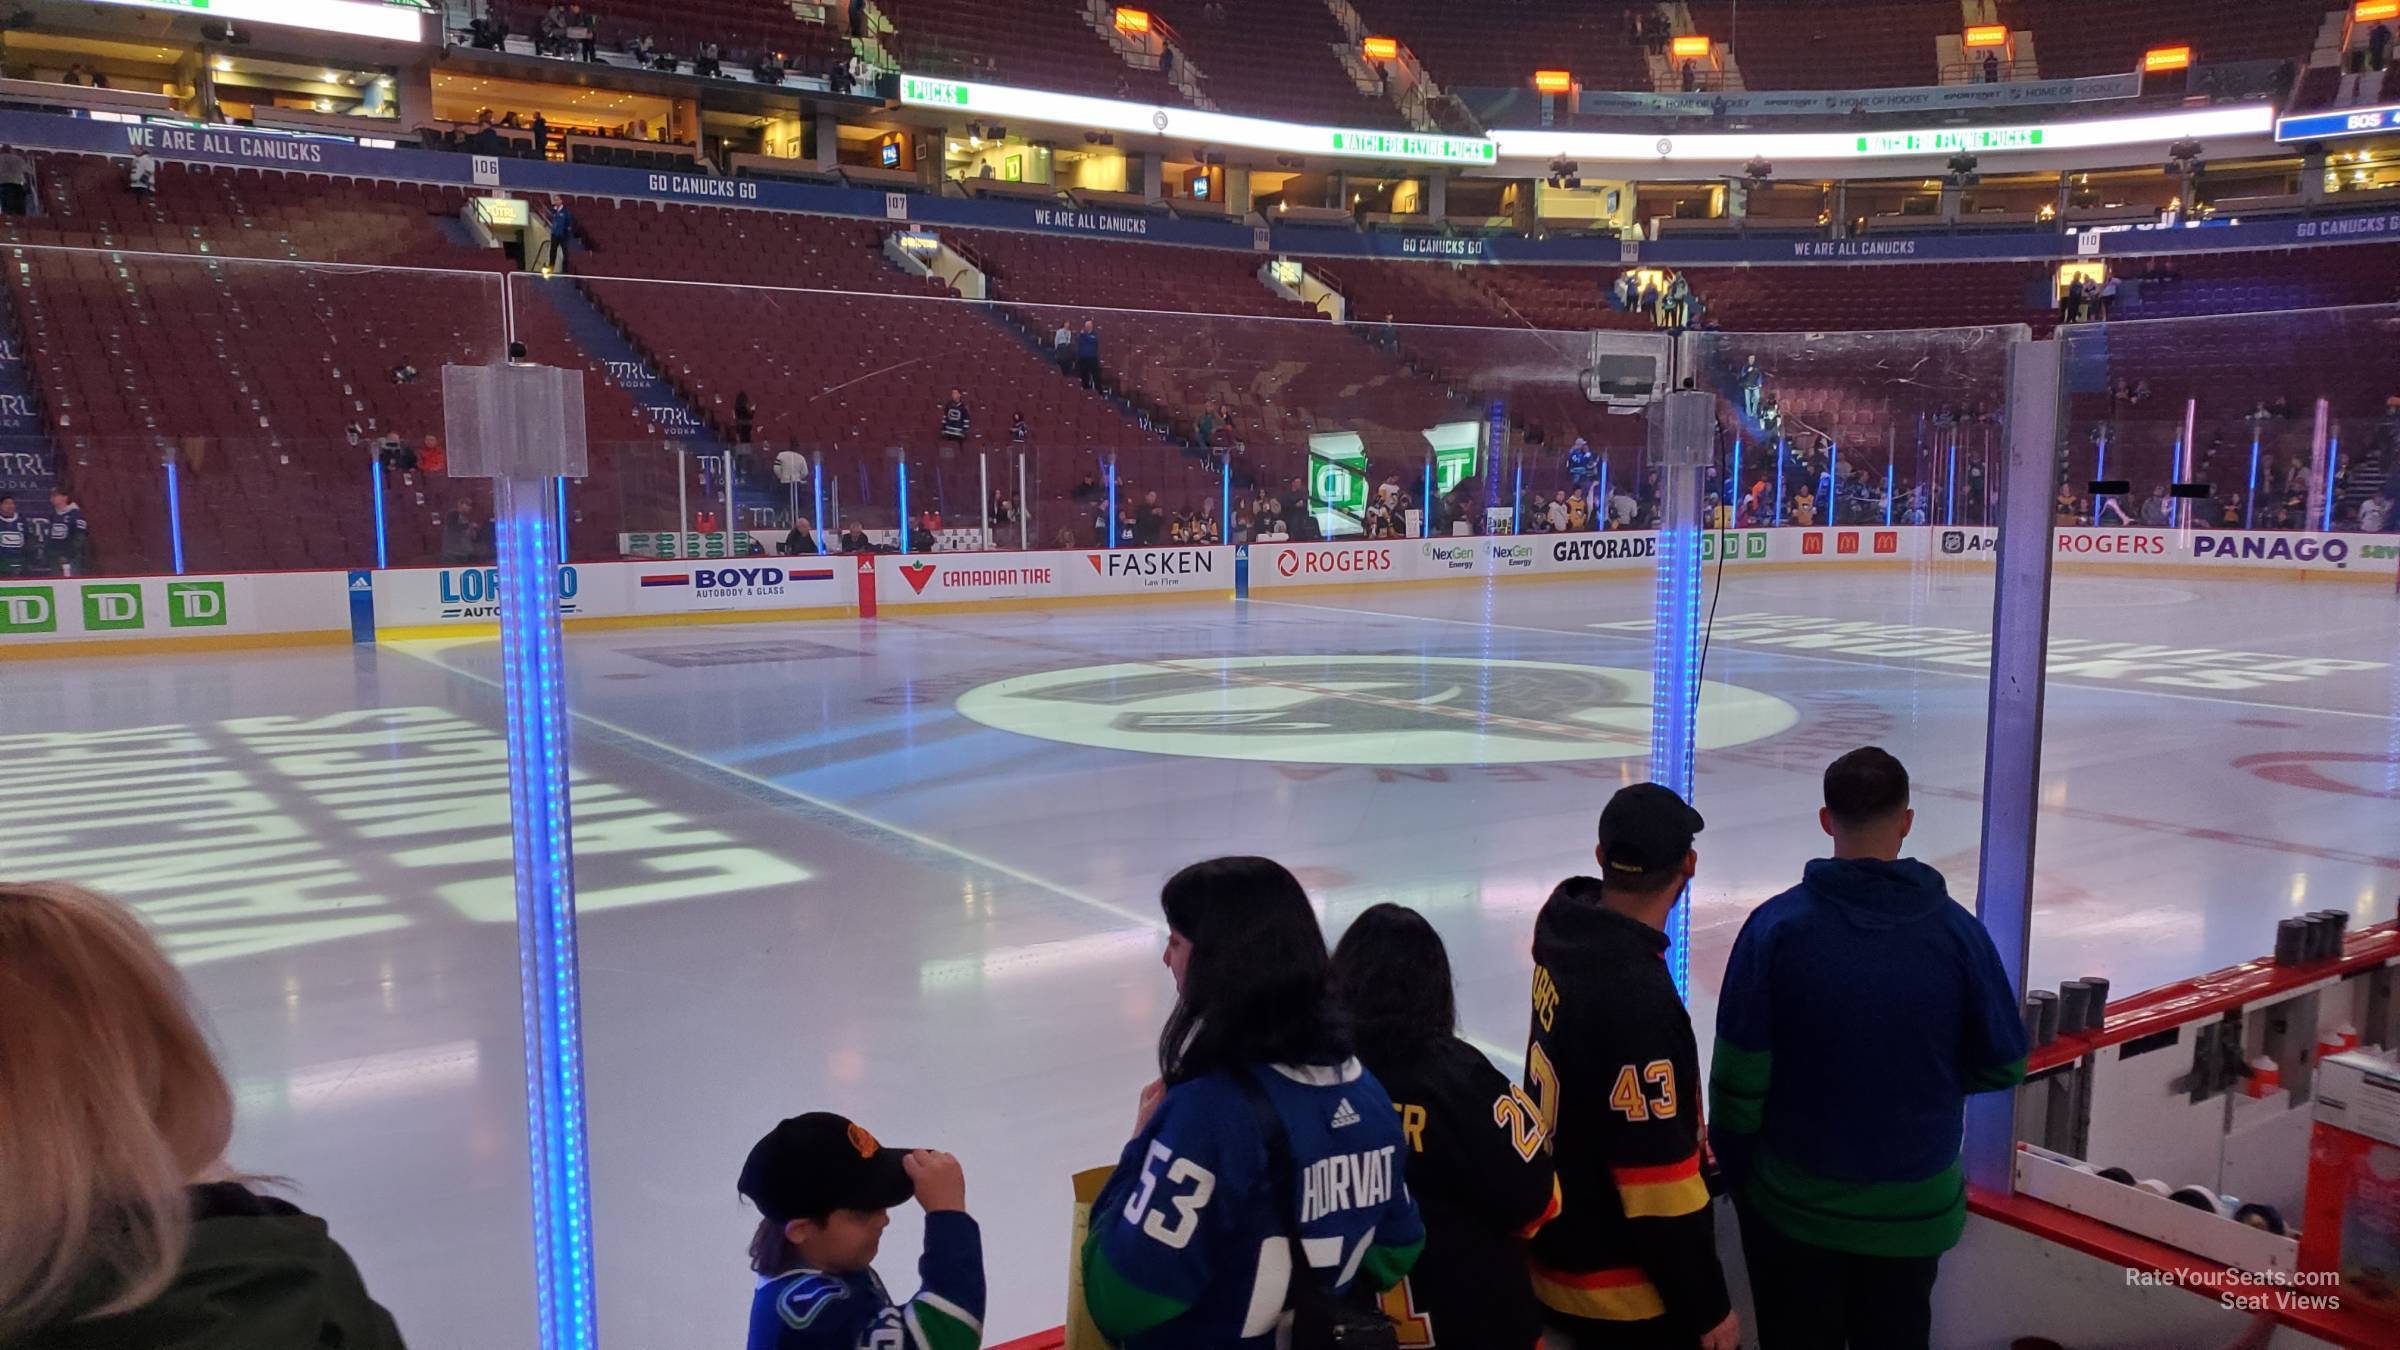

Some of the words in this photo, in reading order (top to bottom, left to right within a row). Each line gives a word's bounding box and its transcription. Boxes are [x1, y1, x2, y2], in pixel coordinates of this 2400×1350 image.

[913, 80, 957, 102] PUCKS
[1888, 94, 1929, 105] HOCKEY
[2025, 87, 2057, 97] HOME
[2059, 86, 2073, 95] OF
[2348, 113, 2382, 130] BOS
[127, 126, 154, 148] WE
[162, 130, 196, 151] ARE
[203, 134, 234, 155] ALL
[240, 137, 321, 163] CANUCKS
[1343, 133, 1378, 151] WATCH
[1384, 136, 1403, 153] FOR
[1410, 138, 1442, 155] FLYING
[1451, 141, 1483, 158] PUCKS
[1990, 129, 2029, 146] PUCKS
[475, 160, 497, 175] 106
[650, 174, 667, 192] GO
[672, 176, 735, 198] CANUCKS
[739, 182, 757, 200] GO
[888, 197, 905, 209] 107
[1035, 208, 1051, 225] WE
[1055, 211, 1075, 228] ARE
[1078, 213, 1096, 230] ALL
[1099, 215, 1146, 234] CANUCKS
[2297, 222, 2316, 237] GO
[2321, 216, 2385, 236] CANUCKS
[1403, 238, 1416, 253] GO
[1419, 238, 1464, 255] CANUCKS
[1468, 240, 1482, 255] GO
[1622, 243, 1638, 254] 109
[1794, 242, 1809, 256] WE
[1814, 242, 1834, 255] ARE
[1839, 242, 1858, 255] ALL
[1862, 240, 1915, 255] CANUCKS
[2082, 234, 2097, 246] 110
[619, 380, 651, 388] VODKA
[664, 427, 696, 435] VODKA
[1432, 547, 1474, 561] NexGen
[1493, 545, 1533, 559] NexGen
[1553, 537, 1656, 562] GATORADE
[1748, 536, 1765, 553] TD
[2058, 535, 2165, 554] ROGERS
[1109, 551, 1212, 577] FASKEN
[1305, 549, 1391, 573] ROGERS
[1449, 560, 1473, 569] Energy
[1508, 558, 1532, 567] Energy
[440, 566, 578, 603] LORO
[695, 567, 783, 589] BOYD
[943, 570, 1018, 587] CANADIAN
[1022, 568, 1051, 584] TIRE
[1144, 577, 1161, 588] Law
[1163, 577, 1179, 587] Firm
[696, 587, 742, 598] AUTOBODY
[746, 587, 753, 597] &
[756, 586, 785, 596] GLASS
[0, 595, 49, 625] TD
[87, 592, 138, 621] TD
[173, 589, 220, 618] TD
[1610, 1059, 1677, 1121] 43
[1494, 1083, 1547, 1163] 21
[1123, 1139, 1216, 1249] 53
[1301, 1146, 1395, 1223] HORVAT
